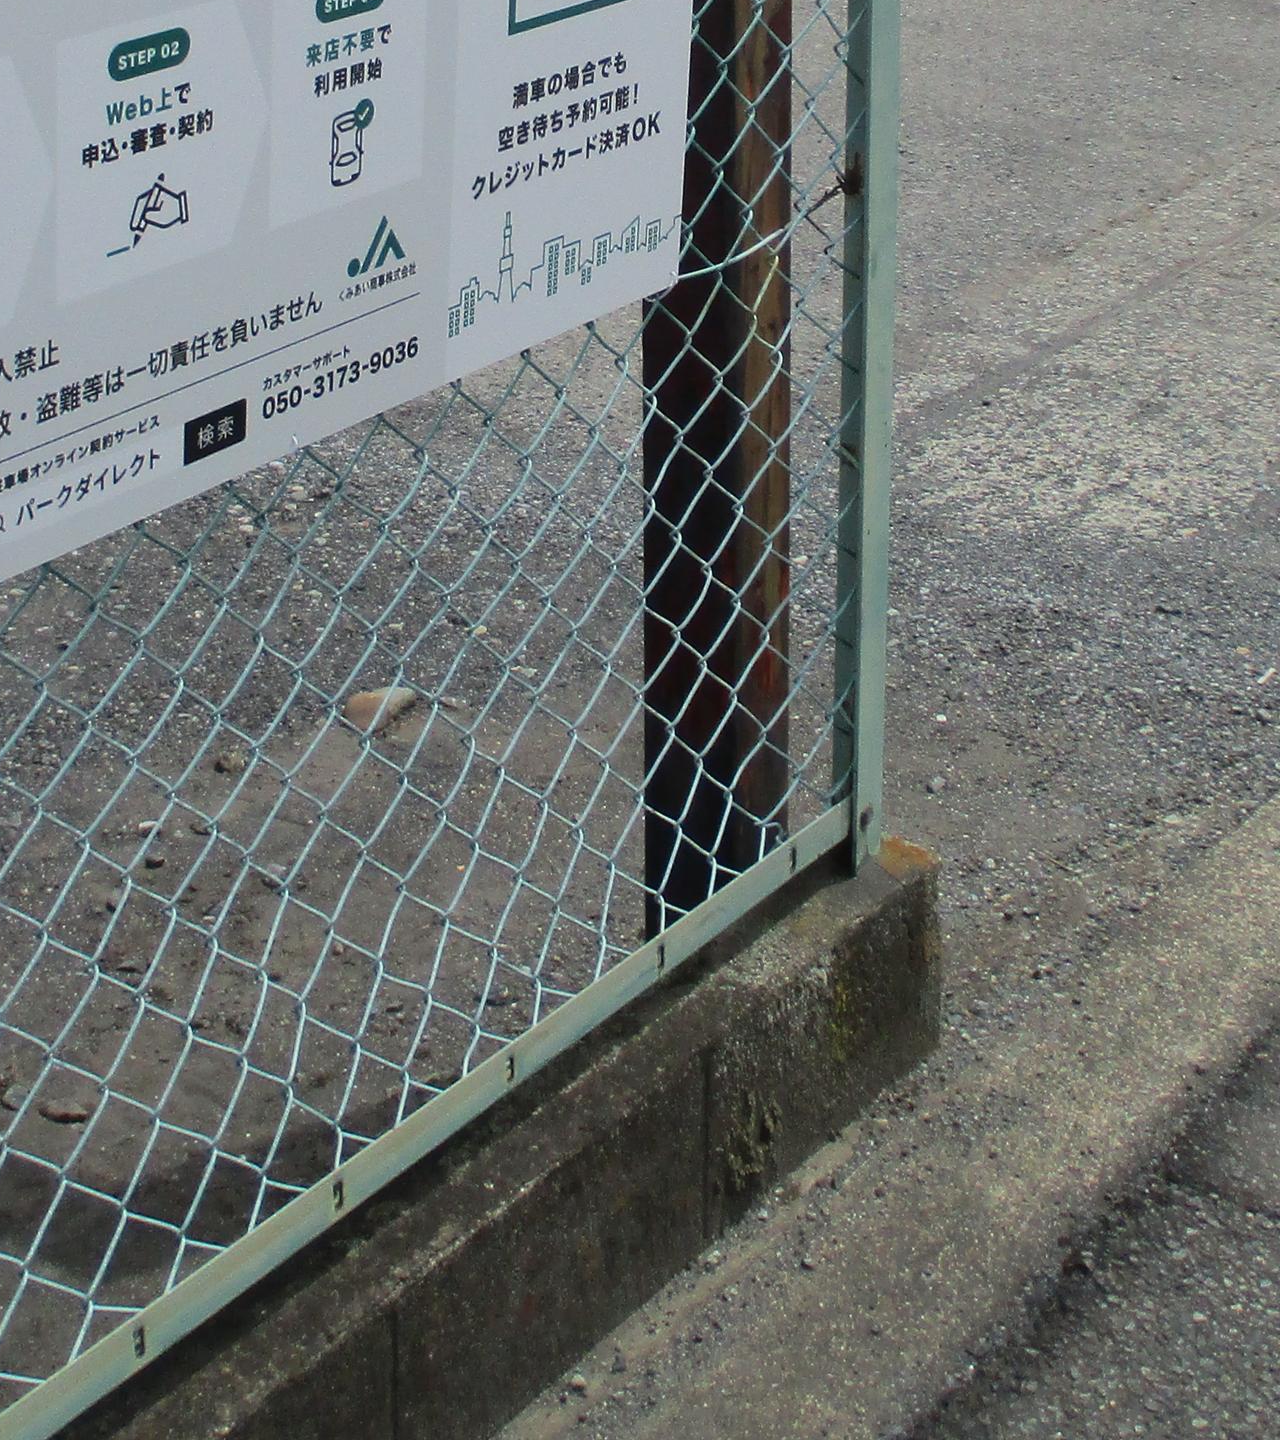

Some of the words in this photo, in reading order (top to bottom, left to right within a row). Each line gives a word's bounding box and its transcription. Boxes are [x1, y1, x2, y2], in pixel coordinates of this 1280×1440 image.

[118, 47, 156, 71] STEP
[161, 41, 180, 59] 02
[306, 24, 393, 68] 来店不要で
[314, 57, 383, 98] 利用開始
[512, 51, 628, 110] 満車の場合でも
[106, 82, 191, 126] Web上で
[82, 108, 214, 169] 申込・審査・契約
[471, 111, 662, 200] クレジットカード決済OK
[262, 336, 419, 420] 050-3173-9036
[263, 344, 351, 392] カスタマーサポート
[197, 415, 235, 449] 検索
[16, 448, 161, 526] パークダイレクト
